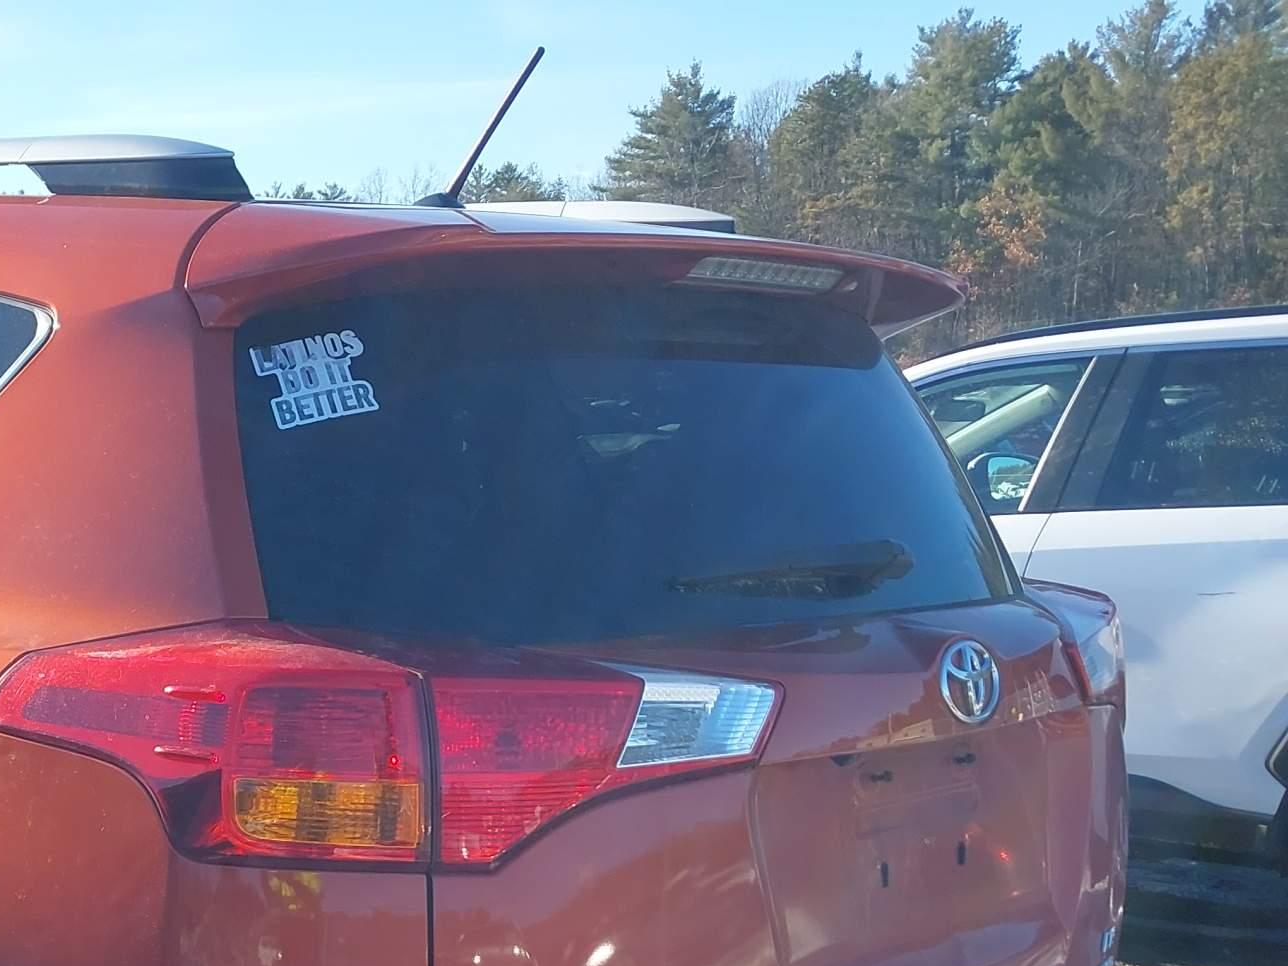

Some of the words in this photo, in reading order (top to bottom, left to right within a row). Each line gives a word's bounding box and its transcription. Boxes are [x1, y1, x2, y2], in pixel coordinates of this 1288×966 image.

[252, 330, 364, 373] LATINOS
[281, 365, 320, 394] DO
[325, 359, 352, 386] IT
[274, 383, 376, 426] BETTER
